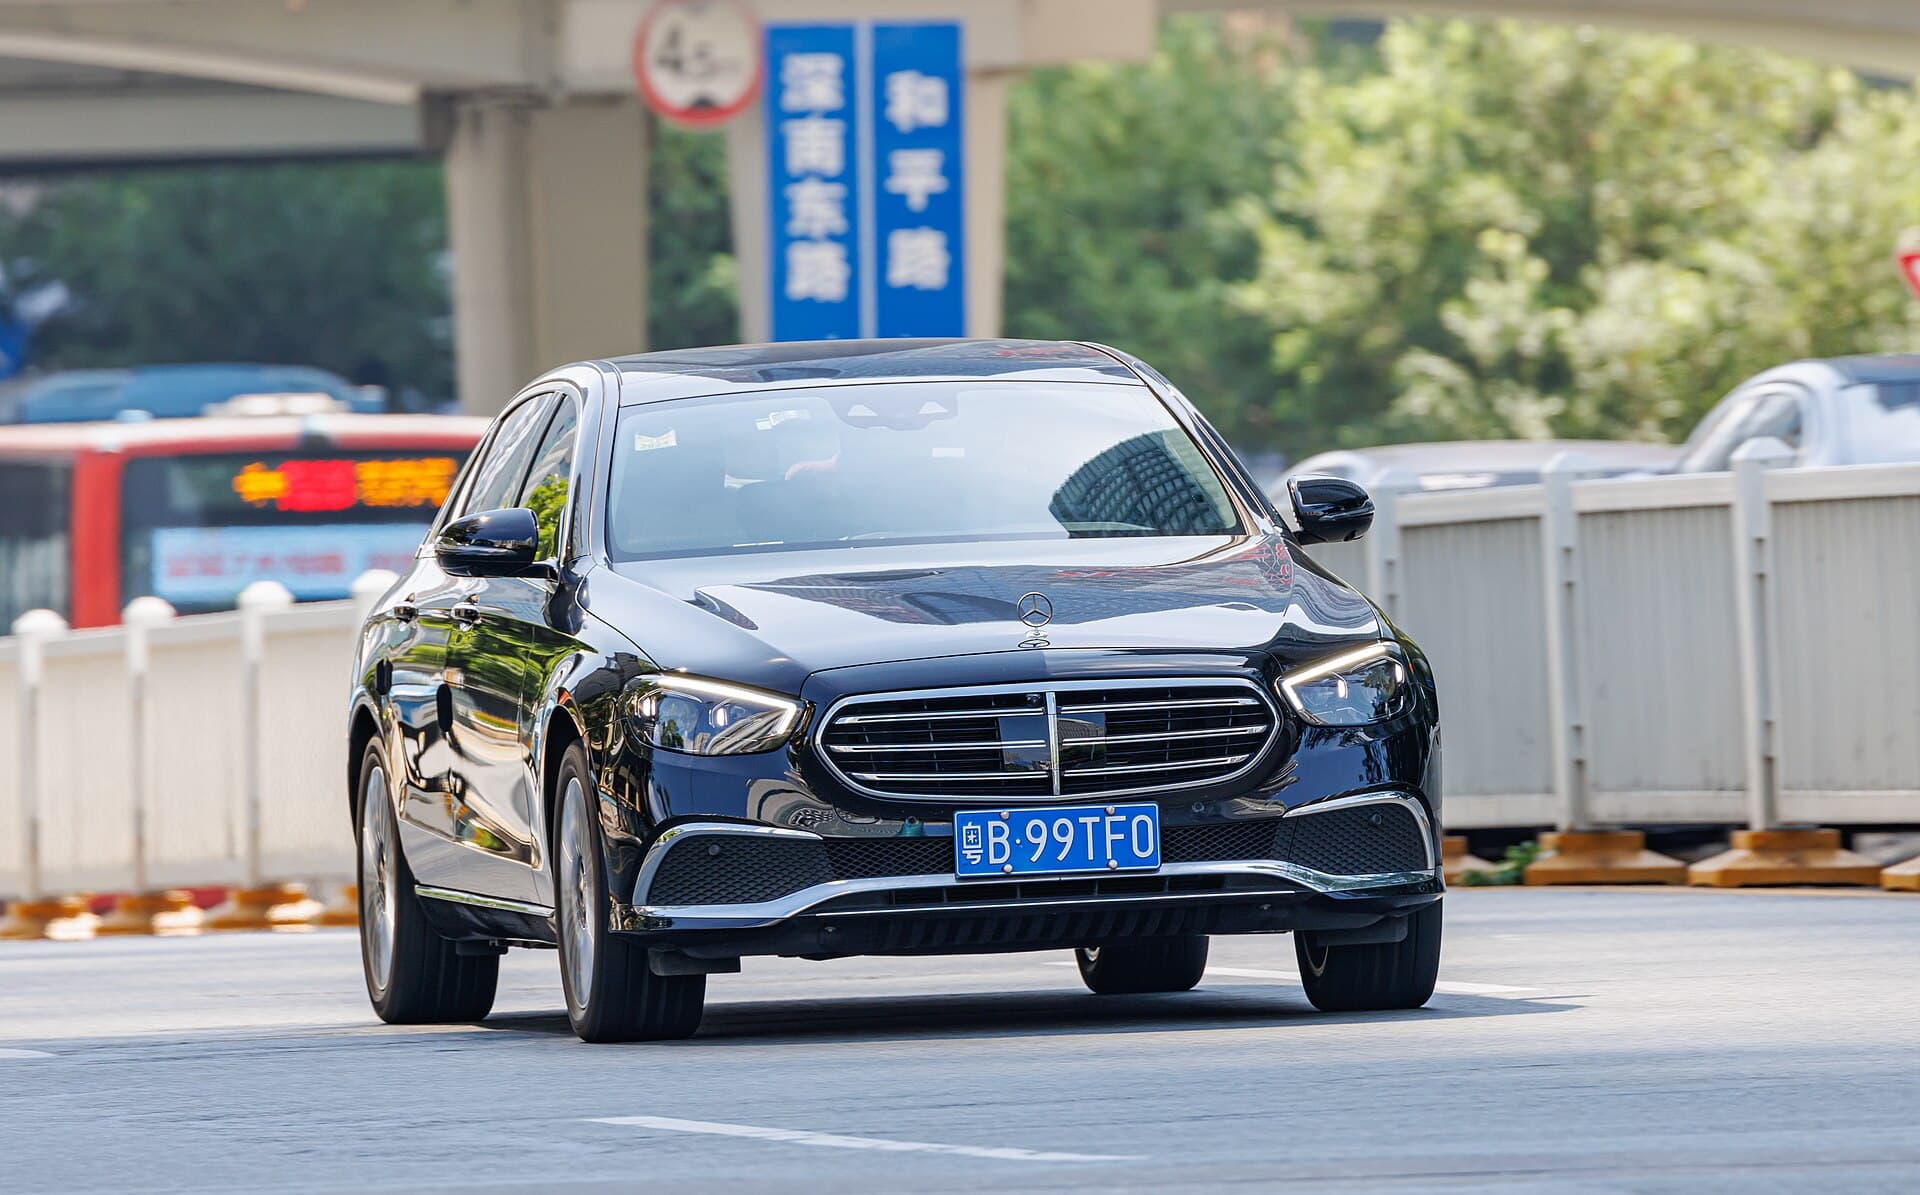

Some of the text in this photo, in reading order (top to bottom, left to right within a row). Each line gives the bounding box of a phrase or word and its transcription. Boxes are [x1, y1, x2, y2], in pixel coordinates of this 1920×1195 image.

[781, 52, 850, 302] 深南东路
[885, 70, 950, 290] 和平路
[962, 815, 1155, 866] 粤B·99TF0
